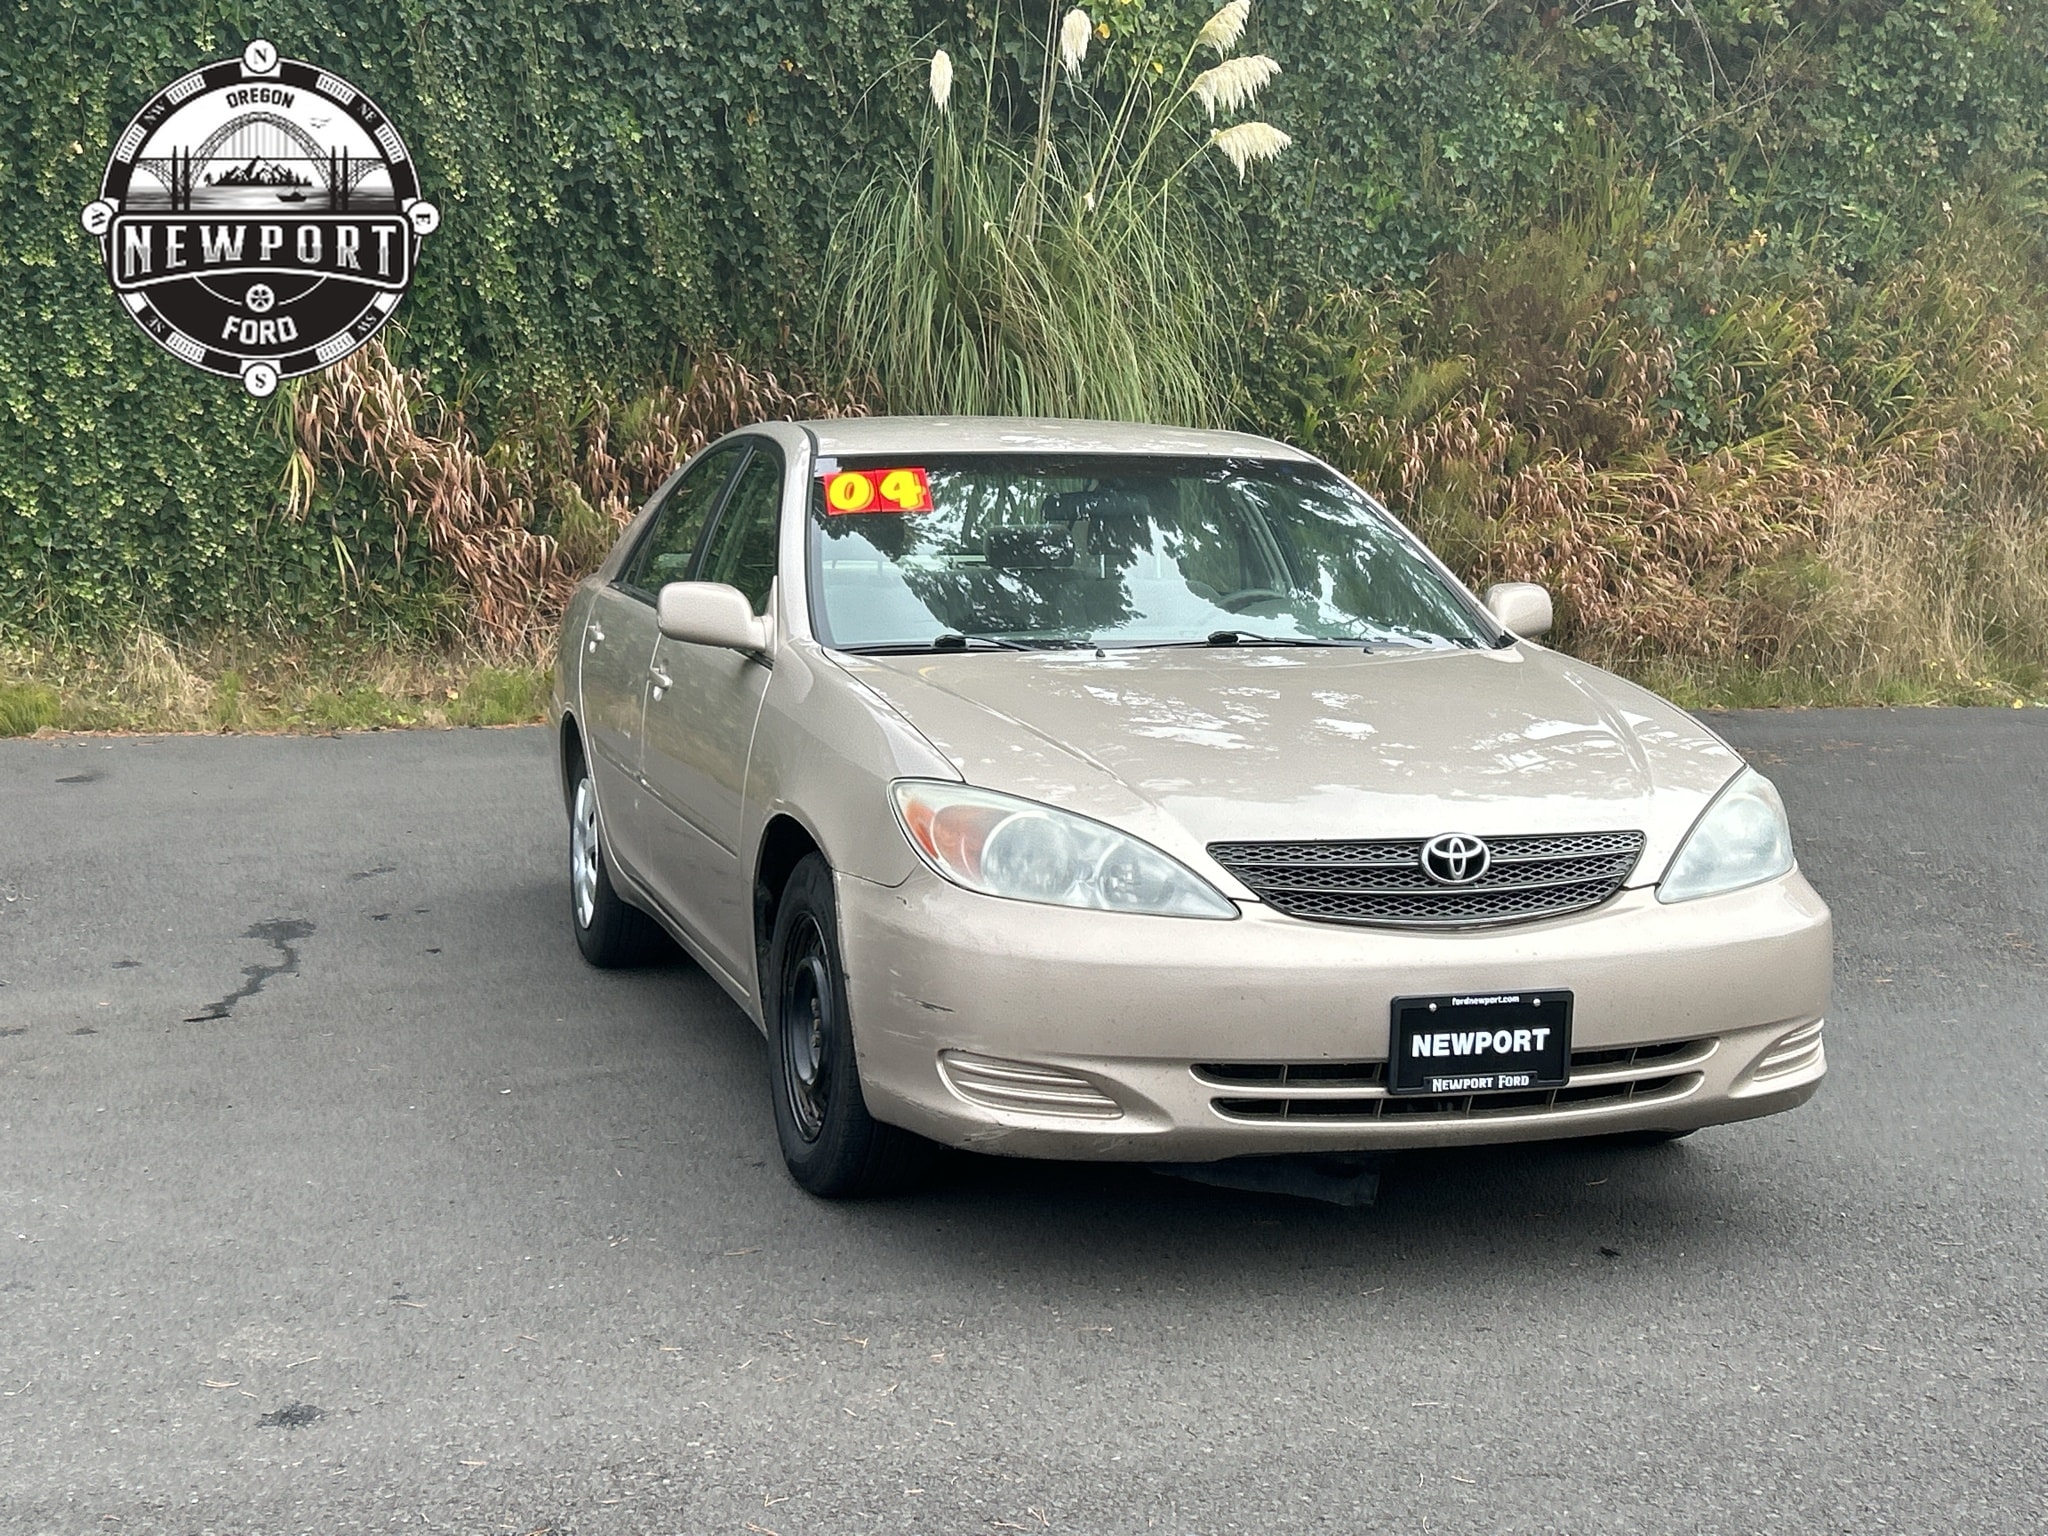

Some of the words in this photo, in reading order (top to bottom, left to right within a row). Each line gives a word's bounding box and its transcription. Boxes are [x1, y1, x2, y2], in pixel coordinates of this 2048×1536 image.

[829, 470, 927, 511] 04
[1451, 996, 1520, 1006] fordnewport.com
[1411, 1027, 1551, 1058] NEWPORT
[1432, 1077, 1494, 1092] NEWPORT
[1498, 1074, 1530, 1089] FORD
